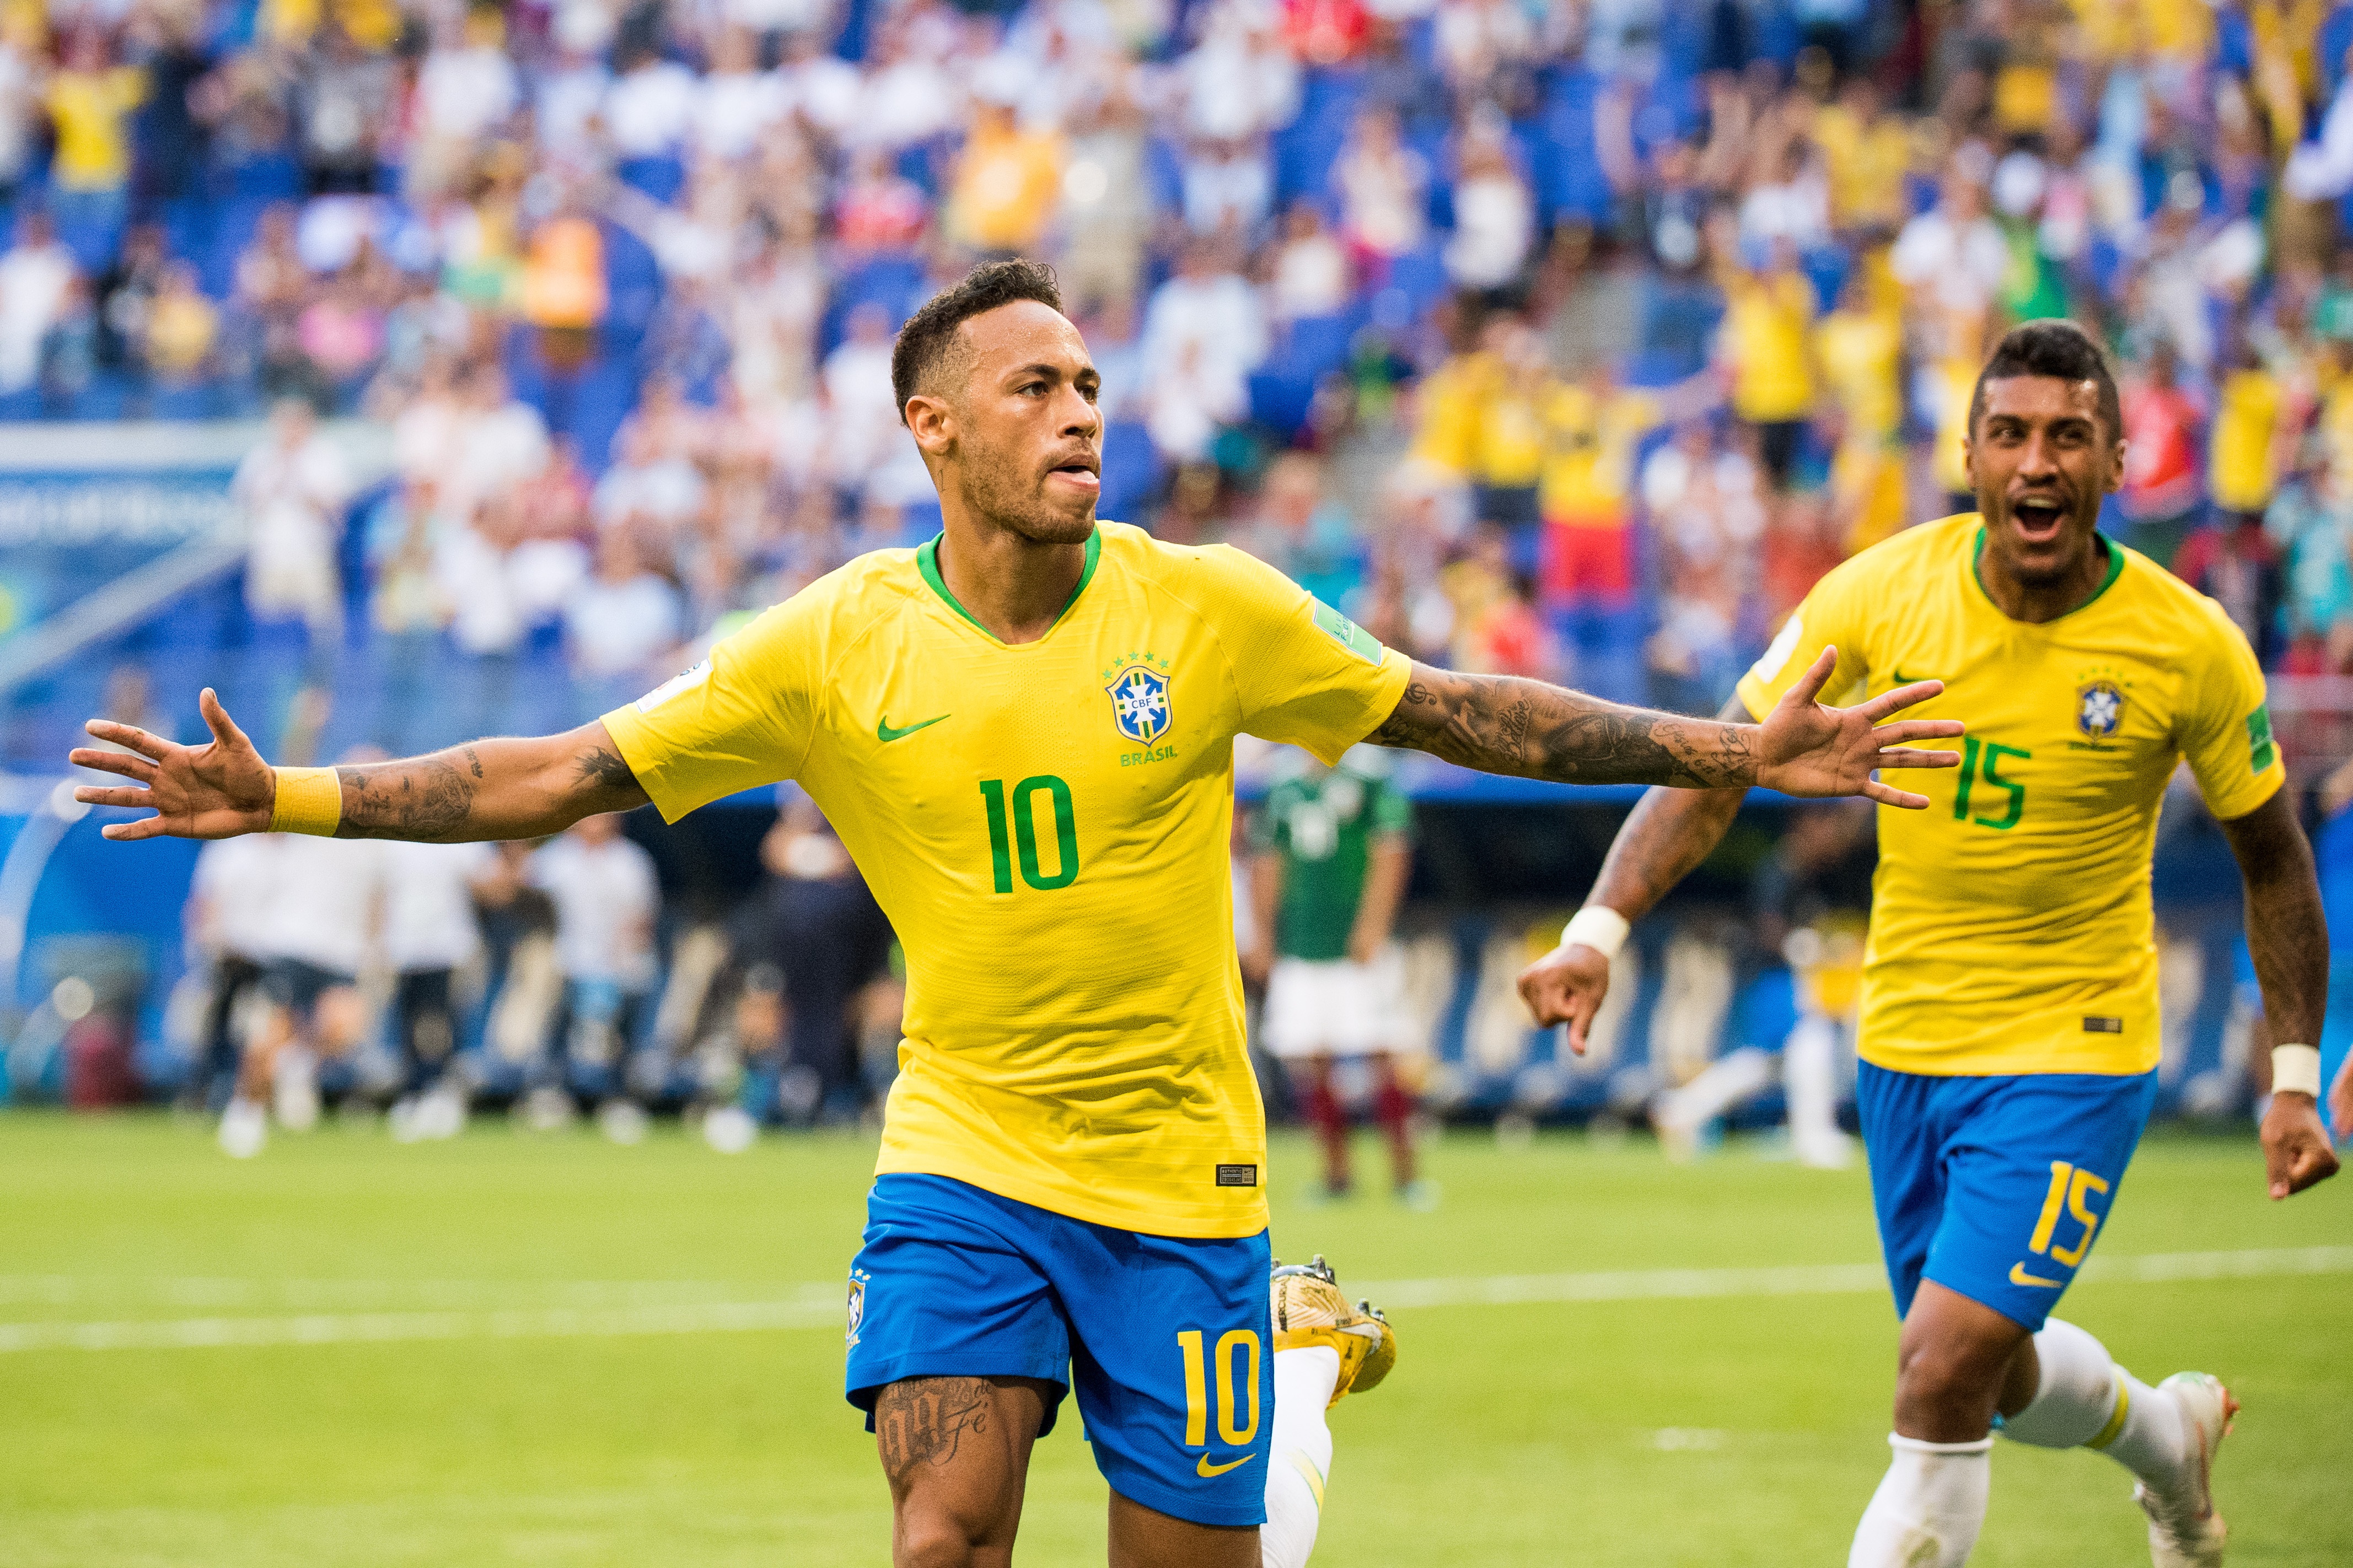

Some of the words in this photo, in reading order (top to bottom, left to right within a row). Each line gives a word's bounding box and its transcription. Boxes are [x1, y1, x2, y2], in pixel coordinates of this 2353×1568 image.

[1131, 698, 1152, 709] CBF
[1120, 745, 1178, 767] BRASIL
[1954, 735, 2032, 829] 15
[979, 774, 1079, 893] 10
[2028, 1160, 2110, 1268] 15
[1177, 1329, 1260, 1446] 10
